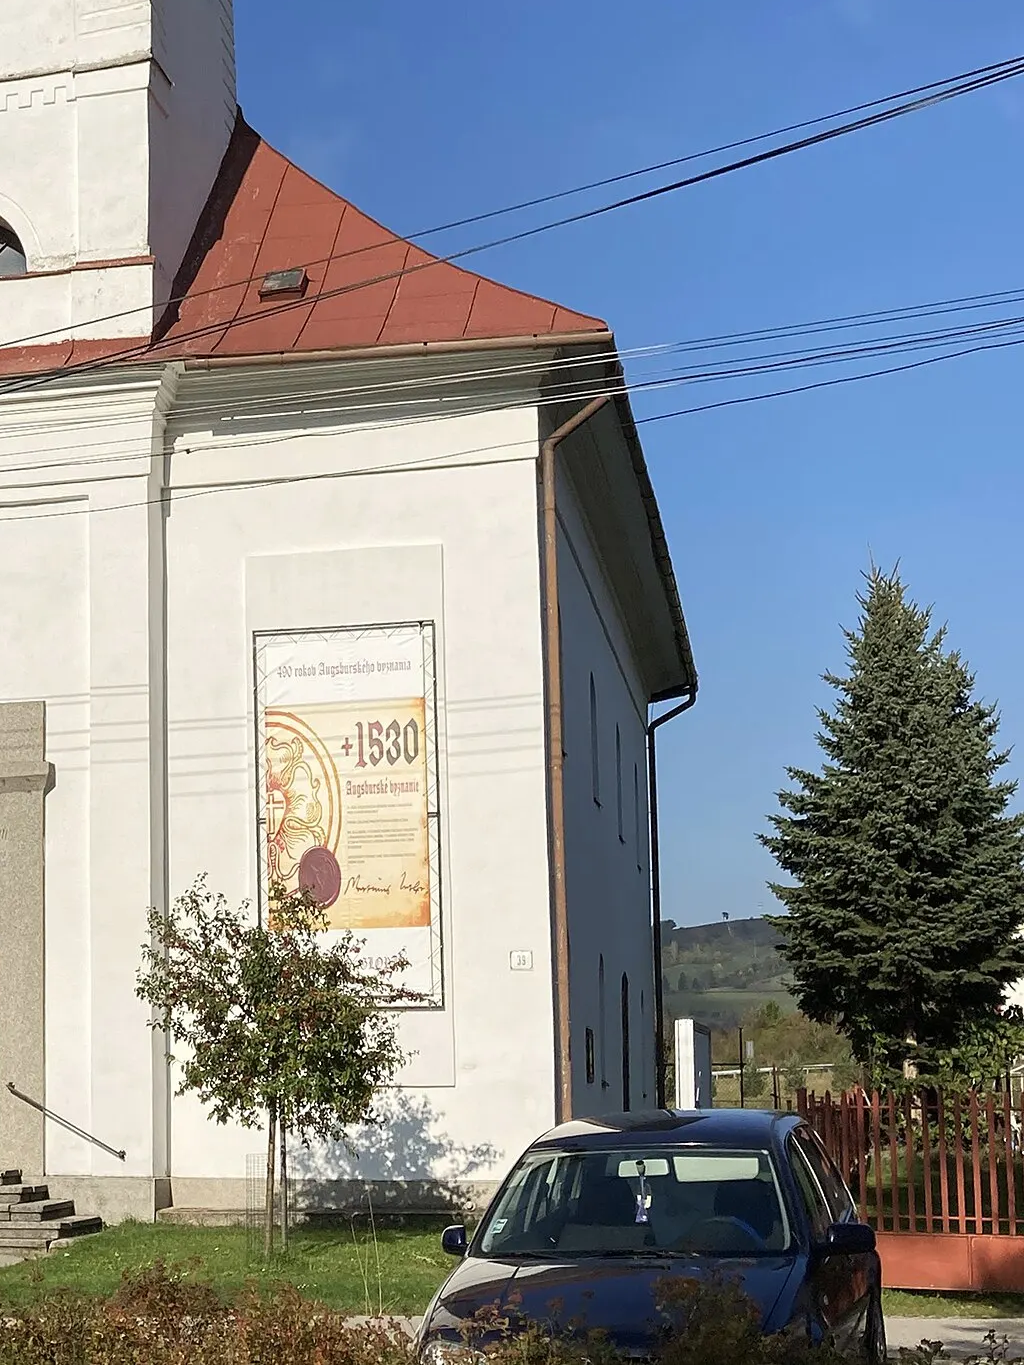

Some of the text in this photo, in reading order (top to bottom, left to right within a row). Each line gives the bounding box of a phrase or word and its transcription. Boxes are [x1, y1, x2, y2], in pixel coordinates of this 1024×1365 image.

[277, 658, 412, 678] 490 rokov Augsburského vyznania
[345, 776, 419, 798] Augsburské vyznanie
